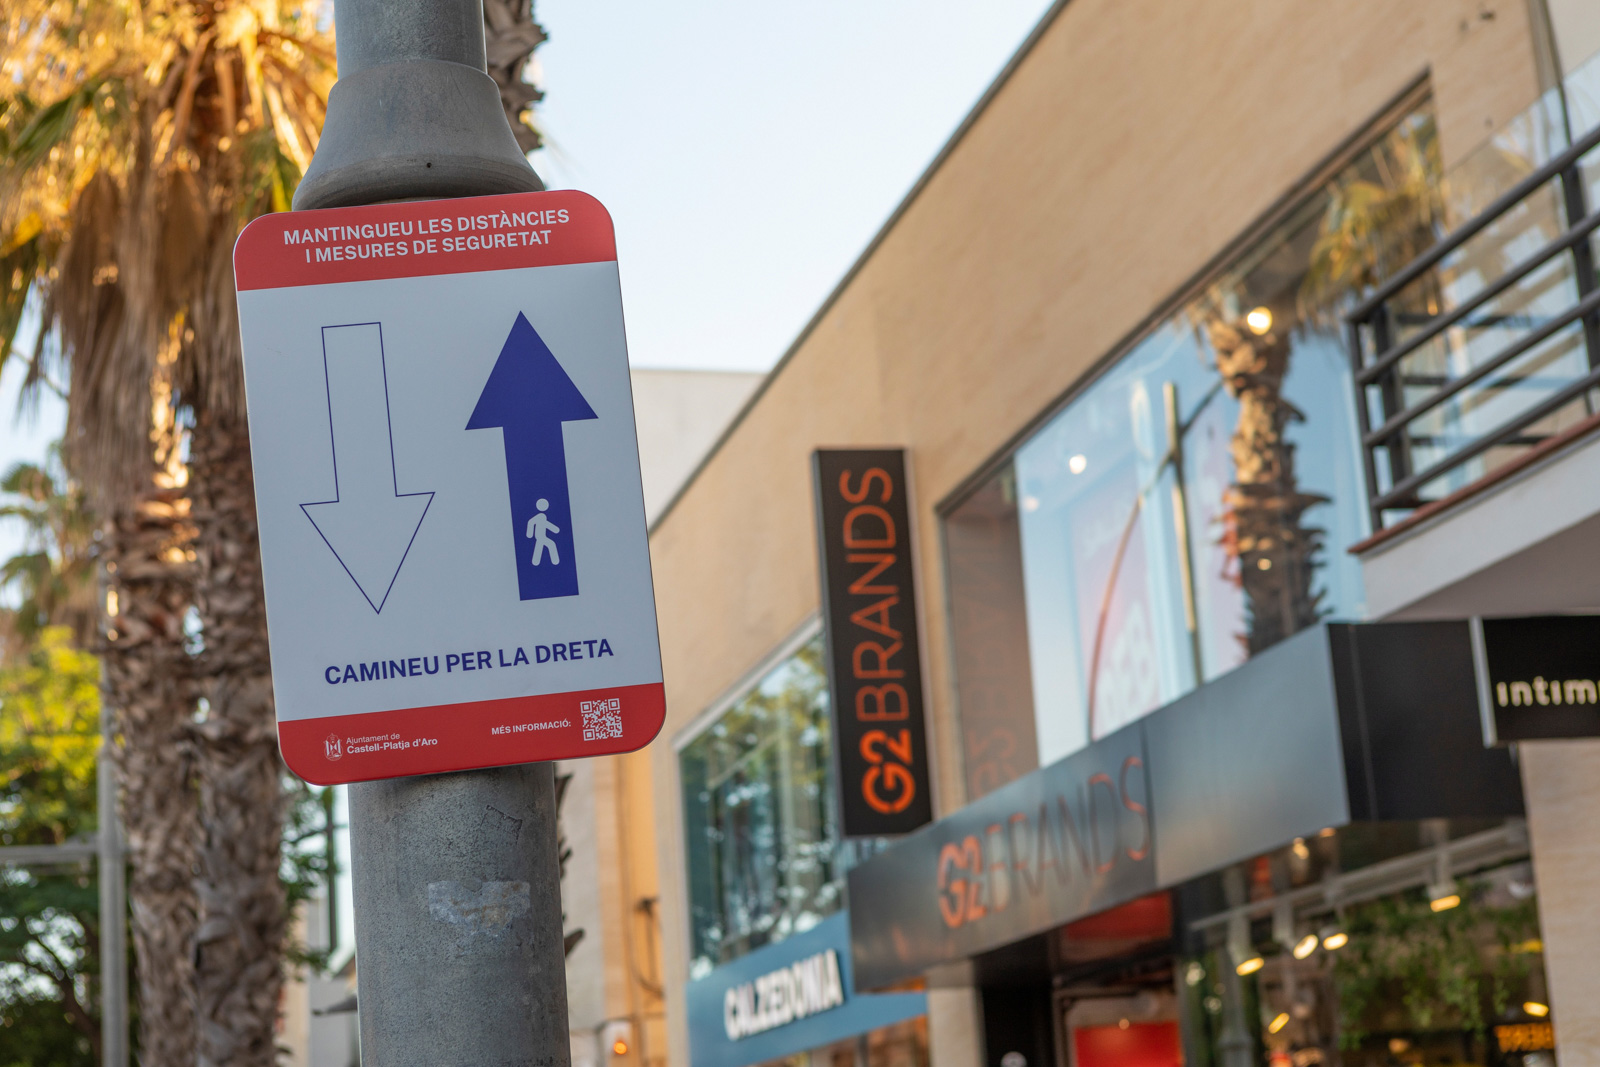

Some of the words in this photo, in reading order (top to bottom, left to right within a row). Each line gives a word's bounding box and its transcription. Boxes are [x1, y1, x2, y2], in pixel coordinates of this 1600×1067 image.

[284, 221, 413, 245] MANTINGUEU
[418, 218, 453, 235] LES
[457, 209, 570, 232] DISTÀNCIES
[305, 248, 311, 263] I
[316, 241, 408, 263] MESURES
[413, 239, 438, 255] DE
[442, 230, 552, 252] SEGURETAT
[838, 467, 916, 814] G2BRANDS
[325, 656, 440, 685] CAMINEU
[445, 650, 493, 673] PER
[498, 647, 530, 667] LA
[535, 638, 614, 664] DRETA
[1496, 676, 1600, 707] intim
[346, 734, 389, 746] Ajuntament
[390, 733, 401, 741] de
[491, 724, 512, 735] MÉS
[512, 719, 572, 733] INFORMACIÓ:
[346, 740, 410, 755] Castell-Platja
[412, 737, 438, 748] d'Aro
[937, 756, 1149, 928] G2BRANDS
[724, 948, 844, 1041] CALZEDONIA
